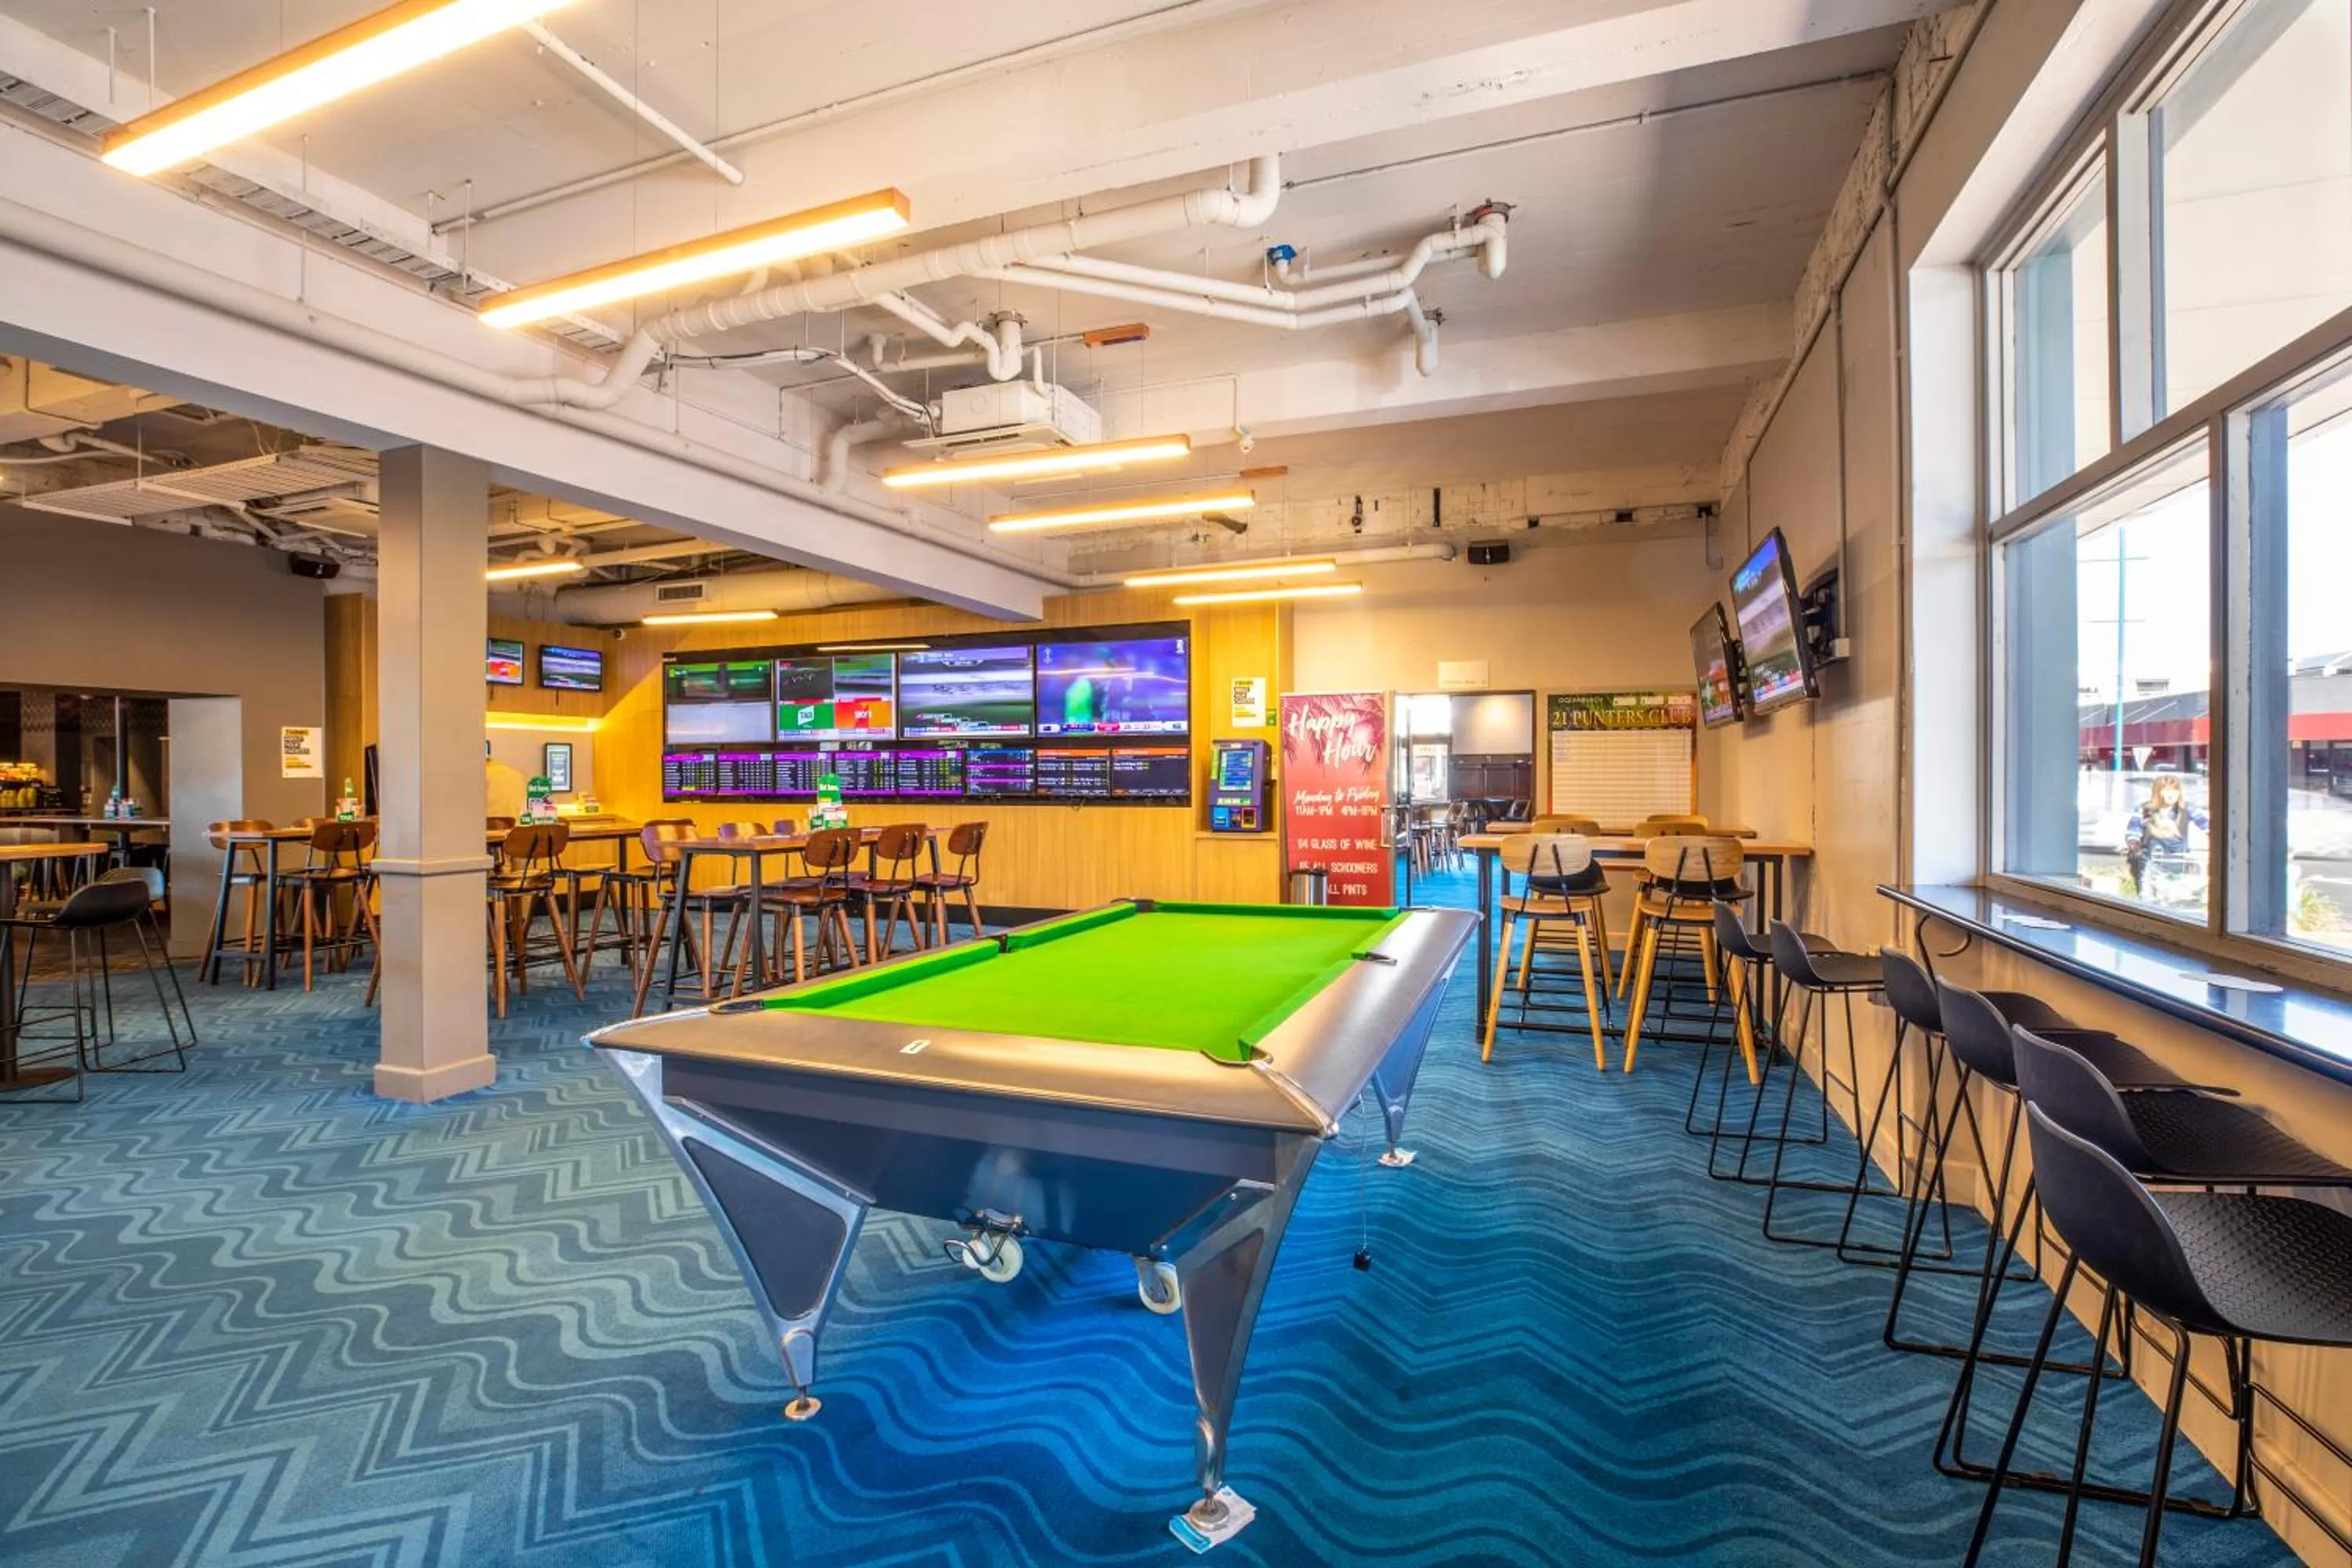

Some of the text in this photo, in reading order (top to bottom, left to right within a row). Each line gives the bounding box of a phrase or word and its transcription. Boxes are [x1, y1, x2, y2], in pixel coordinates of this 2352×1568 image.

[1288, 705, 1356, 740] Happy
[1552, 706, 1691, 726] 21 PUNTERS CLUB
[1323, 732, 1377, 768] Hour
[1294, 786, 1380, 806] Monday to Friday
[1310, 838, 1337, 850] GLASS
[1340, 838, 1352, 850] OF
[1354, 838, 1377, 851] WINE
[1330, 861, 1377, 874] SCHOONERS
[1327, 884, 1368, 896] LL PINTS
